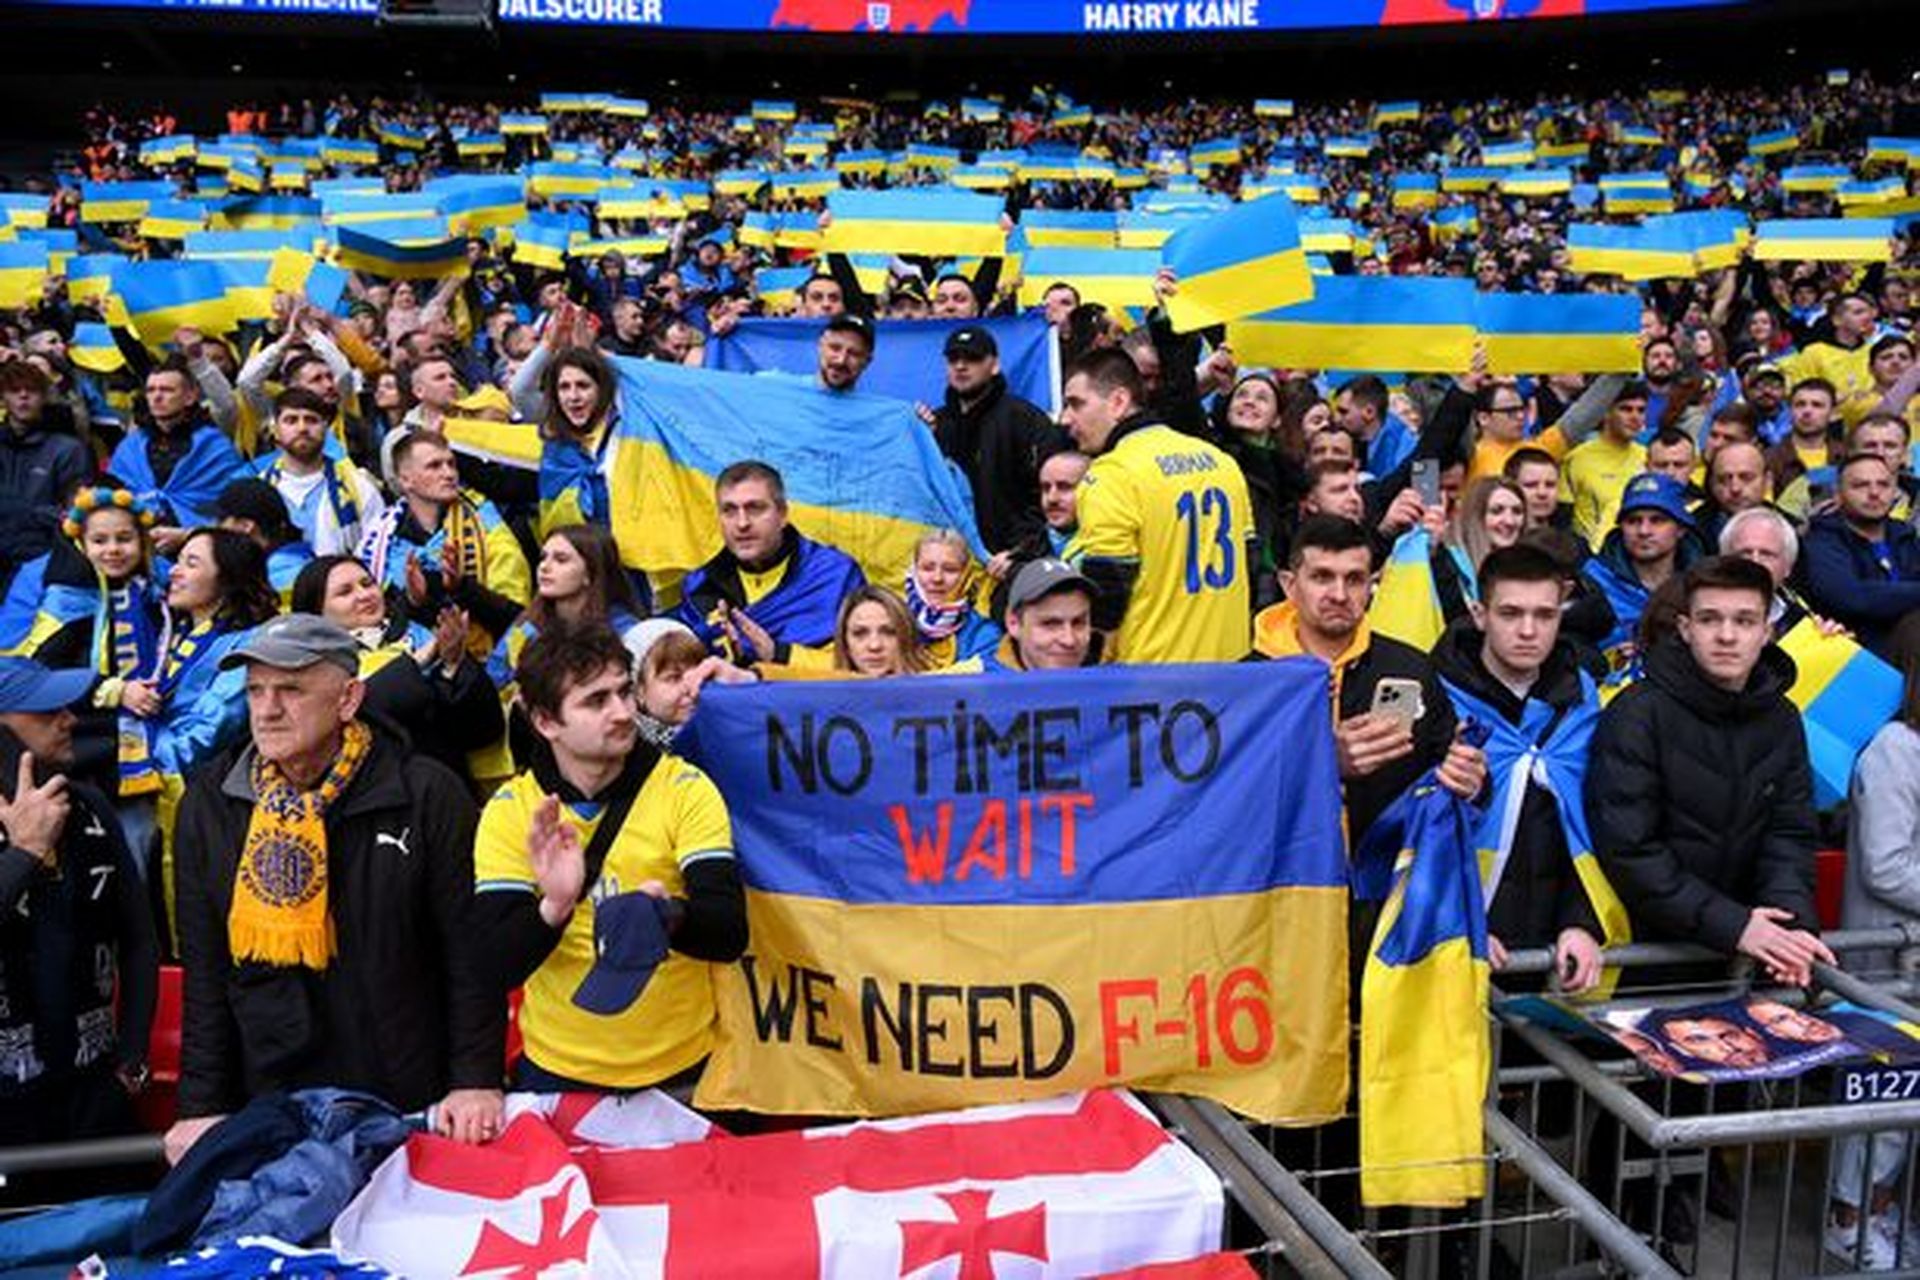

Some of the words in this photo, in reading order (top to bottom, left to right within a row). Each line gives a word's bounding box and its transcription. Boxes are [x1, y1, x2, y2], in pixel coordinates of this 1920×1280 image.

[1084, 3, 1179, 30] HARRY
[1185, 0, 1259, 27] KANE
[1176, 487, 1236, 595] 13
[766, 712, 874, 797] NO
[1108, 698, 1222, 788] TO
[887, 792, 1095, 884] WAIT
[740, 955, 844, 1052] WE
[861, 976, 1076, 1080] NEED
[1098, 965, 1274, 1077] F-16
[1845, 1069, 1920, 1100] B127
